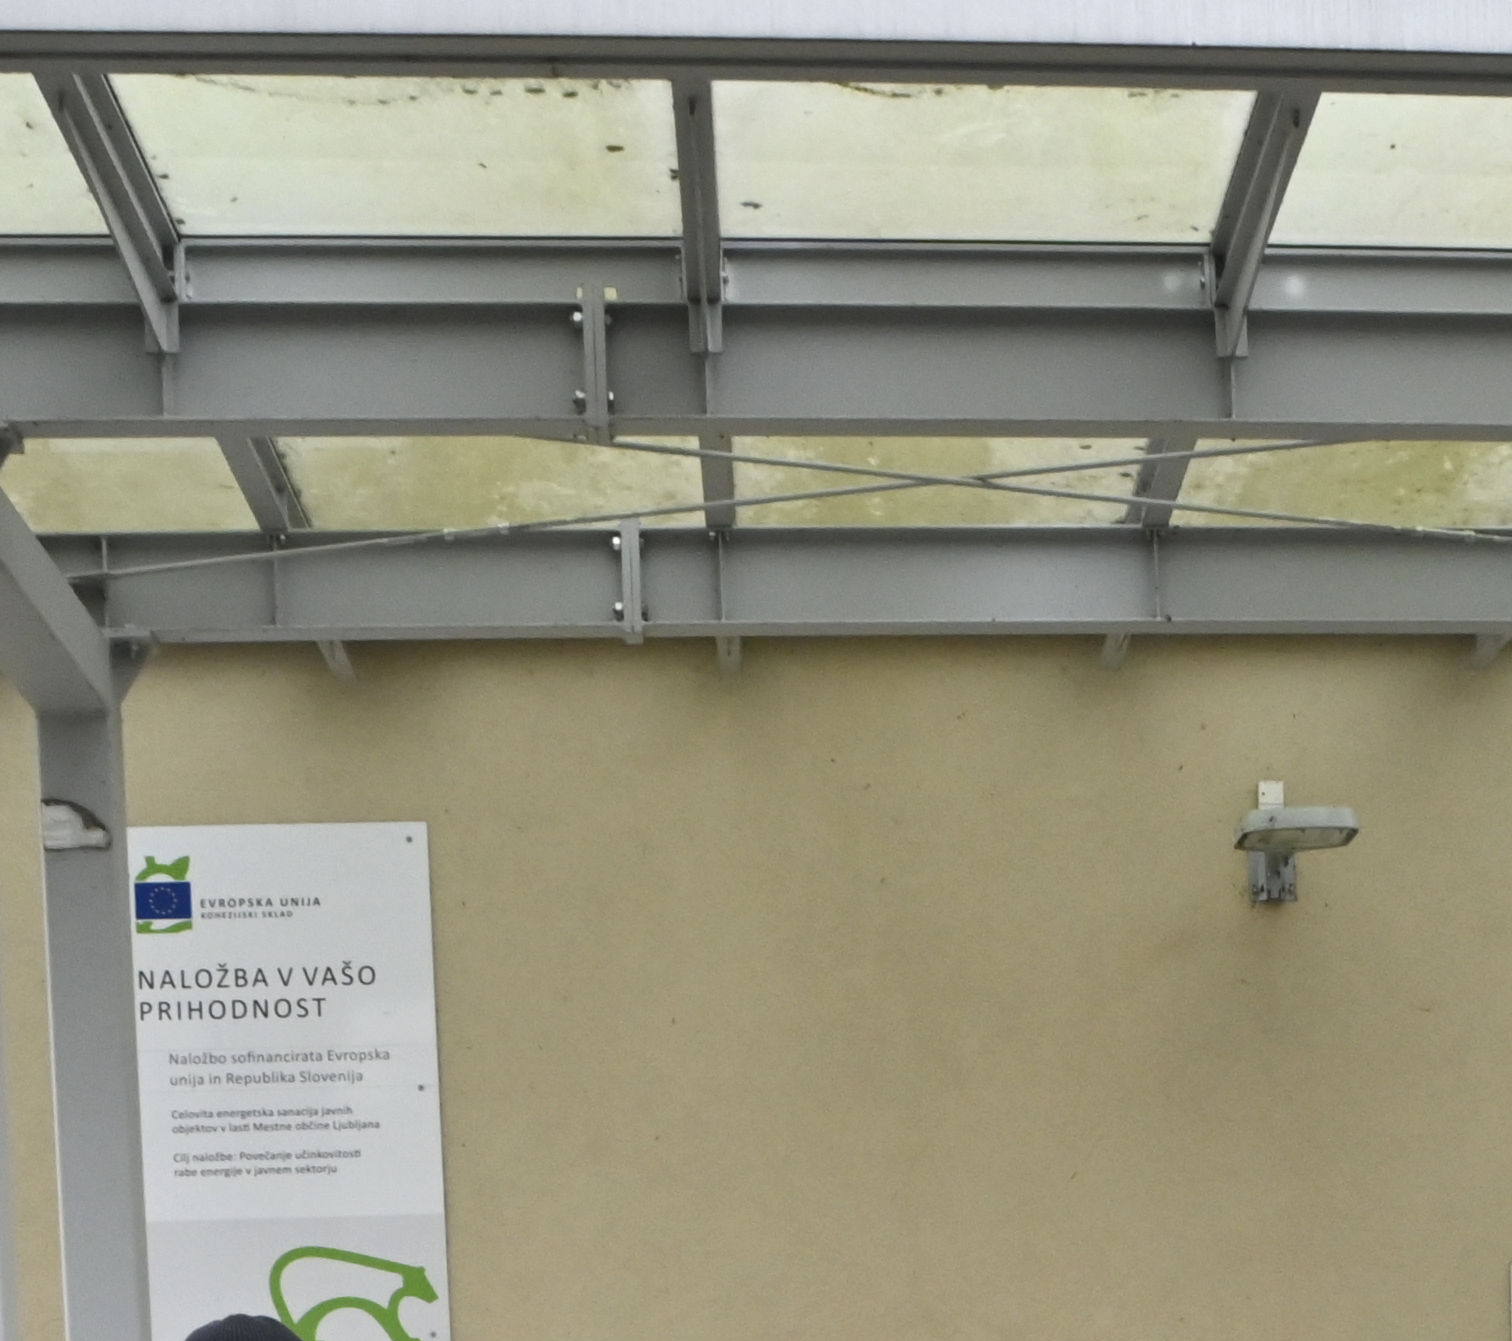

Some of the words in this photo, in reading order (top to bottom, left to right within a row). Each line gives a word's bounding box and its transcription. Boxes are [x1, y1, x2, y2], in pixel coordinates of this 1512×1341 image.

[200, 897, 274, 909] EVROPSKA
[280, 896, 322, 908] UNIJA
[138, 963, 269, 990] NALOŽBA
[277, 967, 294, 987] V
[302, 960, 377, 986] VAŠO
[140, 997, 327, 1021] PRIHODNOST
[169, 1052, 227, 1066] Naložbo
[327, 1048, 390, 1063] Evropska
[169, 1074, 205, 1088] unija
[209, 1073, 222, 1085] in
[226, 1071, 296, 1087] Republika
[299, 1070, 364, 1085] Slovenija
